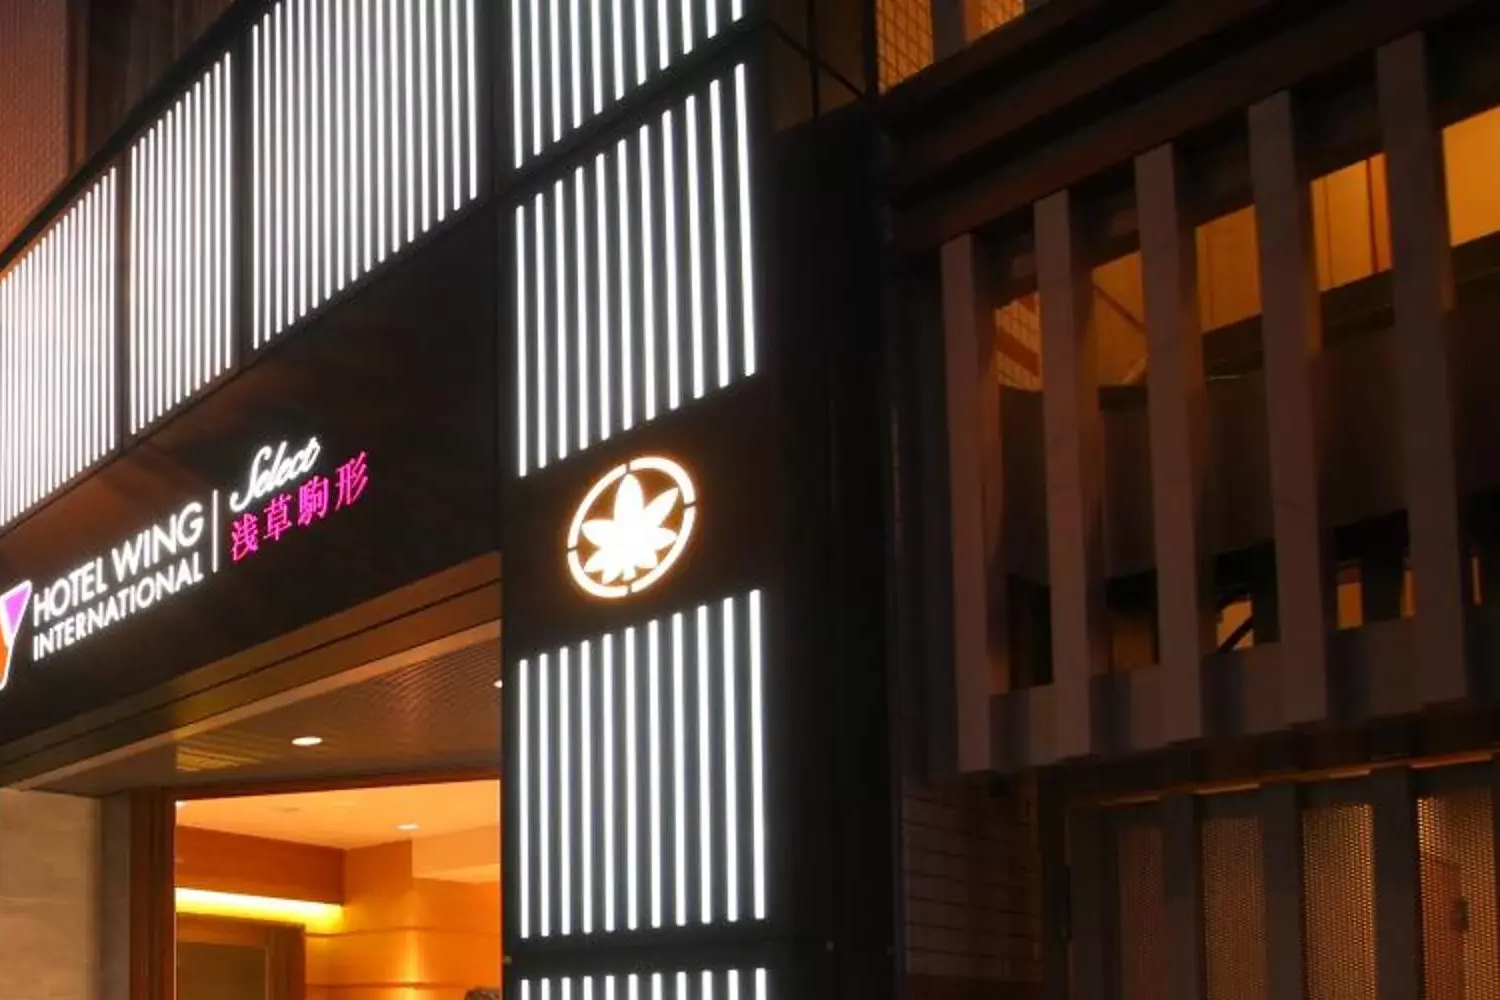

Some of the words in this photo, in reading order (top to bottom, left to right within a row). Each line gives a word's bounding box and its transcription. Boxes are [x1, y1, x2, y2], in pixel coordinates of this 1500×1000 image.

[229, 436, 321, 513] Select
[231, 451, 369, 561] 浅草駒形
[32, 556, 107, 627] HOTEL
[111, 501, 203, 578] WING
[32, 551, 203, 661] INTERNATIONAL
